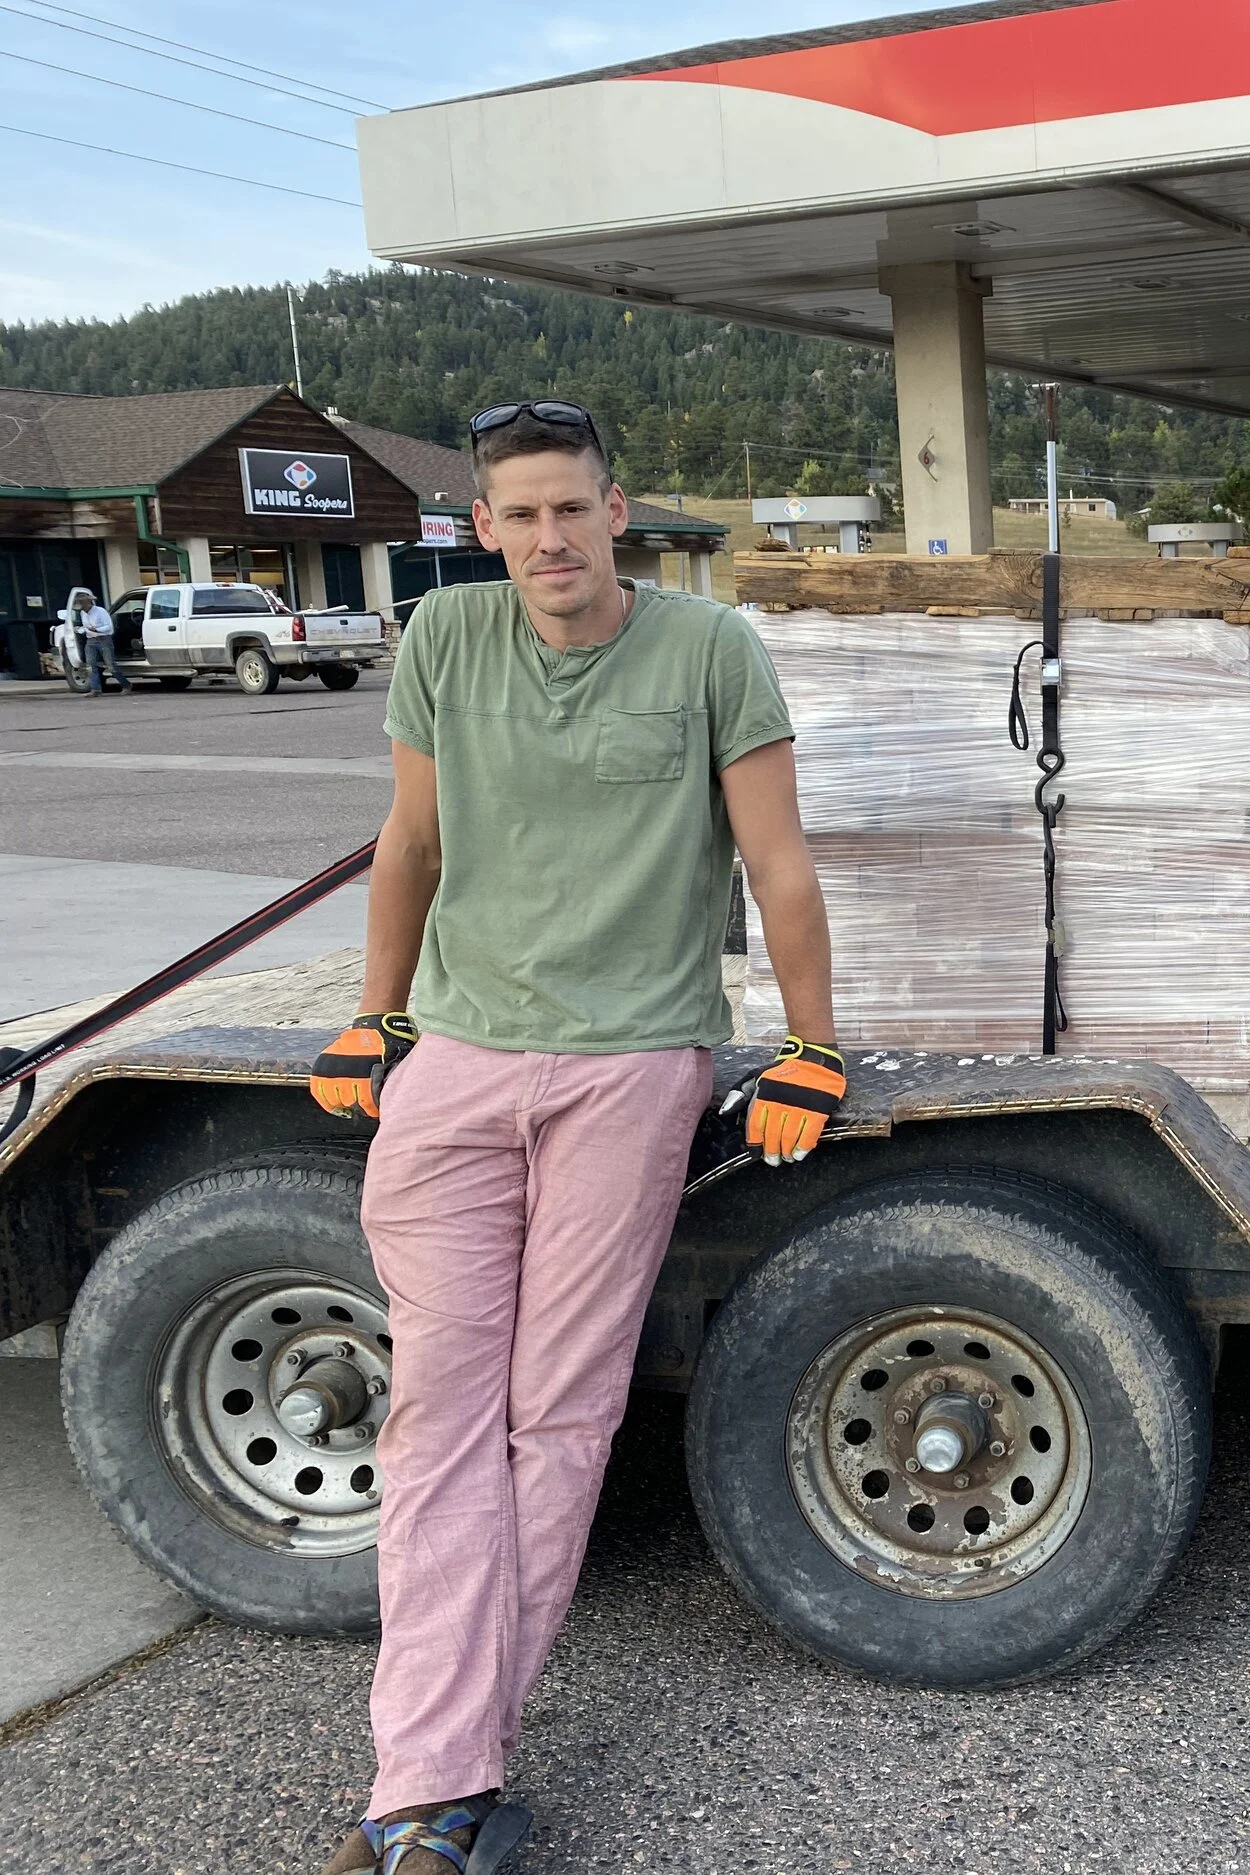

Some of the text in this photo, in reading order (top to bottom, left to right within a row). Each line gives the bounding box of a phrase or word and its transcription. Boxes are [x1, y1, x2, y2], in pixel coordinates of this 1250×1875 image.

[923, 451, 930, 465] 6
[254, 488, 347, 512] KING Soopers
[422, 521, 454, 537] IRING
[310, 626, 377, 635] CHEVROLET
[37, 1051, 52, 1062] LOAD
